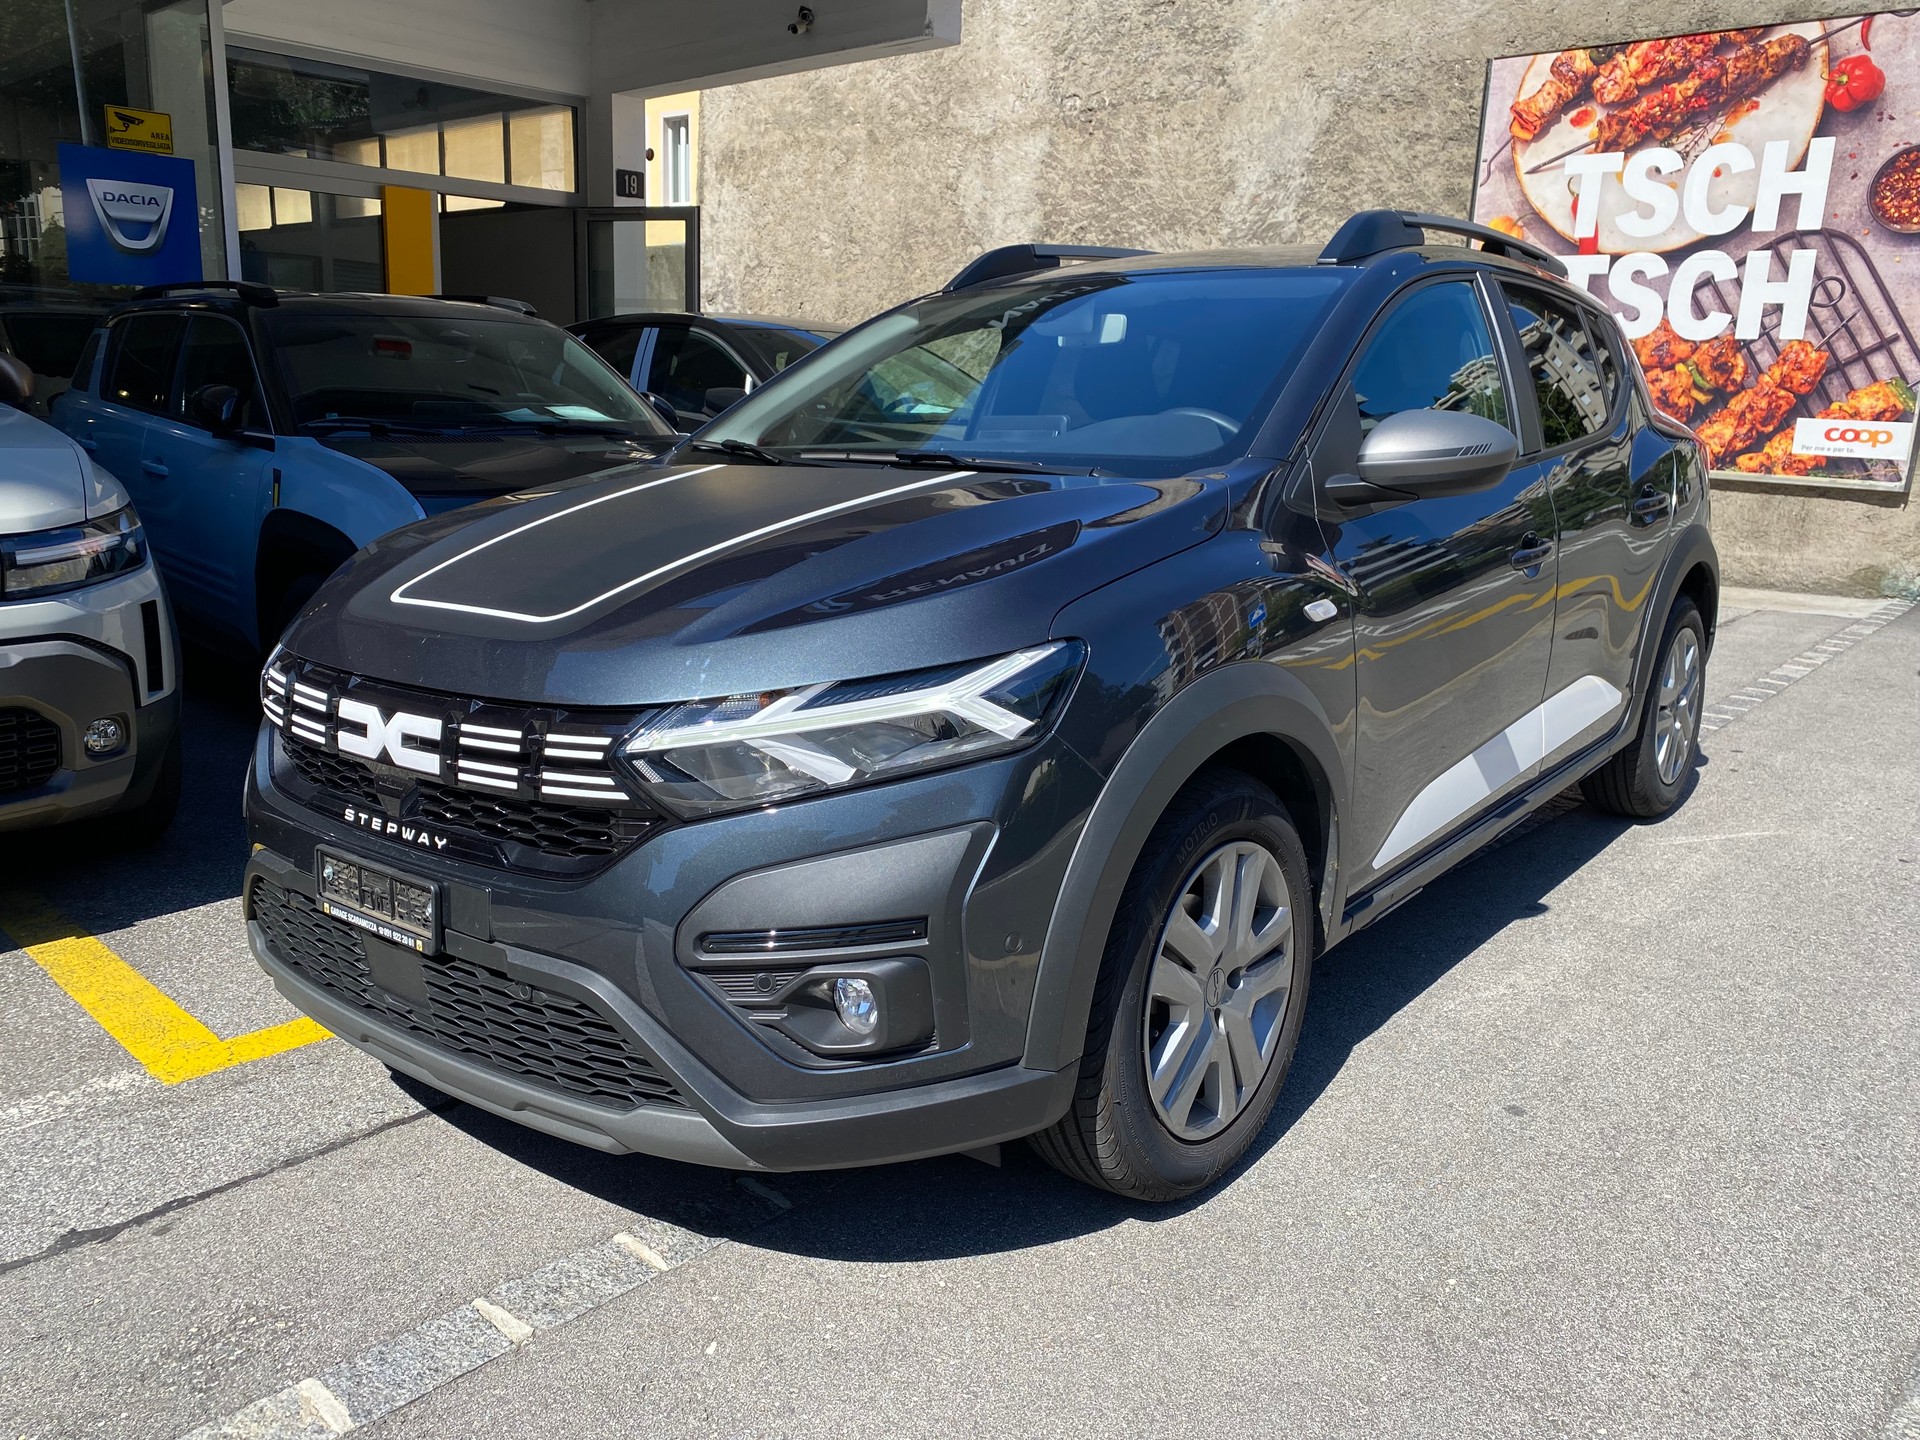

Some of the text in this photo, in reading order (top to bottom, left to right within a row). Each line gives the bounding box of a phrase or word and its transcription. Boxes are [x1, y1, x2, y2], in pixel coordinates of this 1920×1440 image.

[111, 137, 171, 150] VIDEOSORVEGLIATA
[150, 132, 170, 141] AREA
[624, 174, 638, 195] 19
[1564, 136, 1836, 238] TSCH
[103, 191, 160, 207] DACIA
[1824, 427, 1893, 448] coop
[344, 808, 447, 849] STEPWAY
[1176, 812, 1219, 865] MOTRIO
[330, 906, 348, 920] GARAGE
[347, 913, 378, 932] SCARAMOZZA
[392, 931, 401, 941] 922
